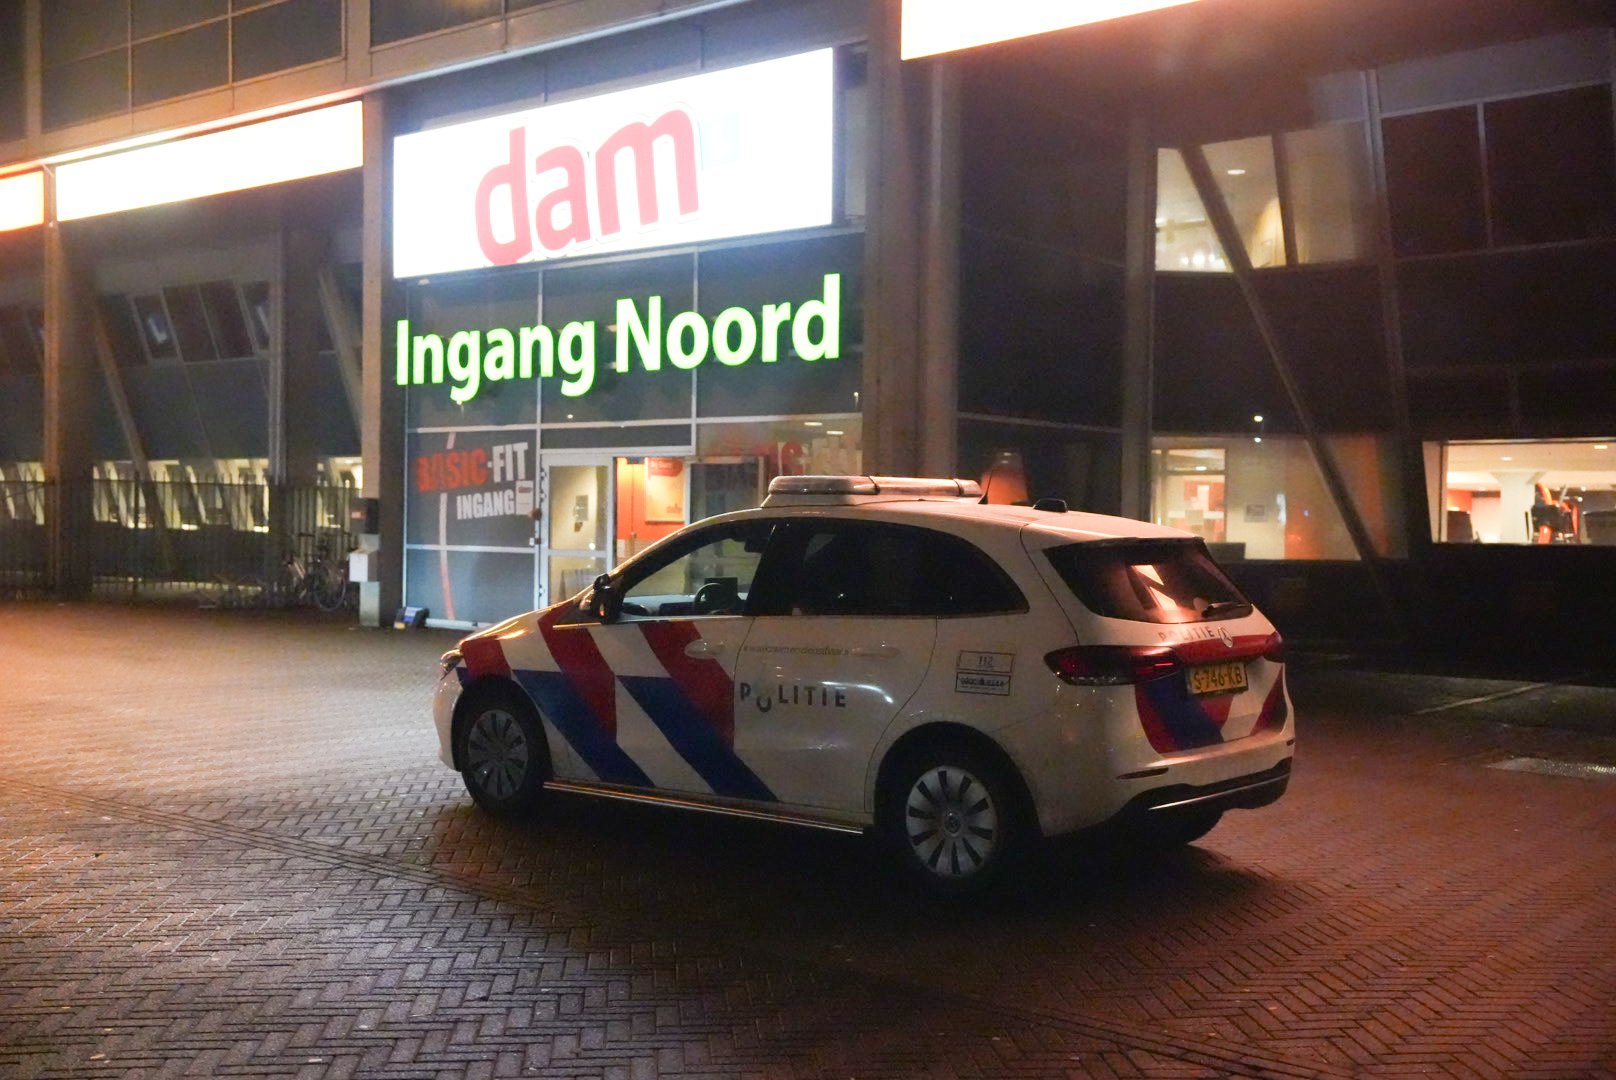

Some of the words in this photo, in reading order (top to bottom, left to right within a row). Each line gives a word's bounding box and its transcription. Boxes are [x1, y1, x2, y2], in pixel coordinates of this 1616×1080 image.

[475, 109, 699, 265] dam
[396, 319, 596, 402] Ingang
[615, 273, 841, 373] Noord
[416, 442, 529, 494] BASIC-FIT
[456, 489, 515, 520] INGANG
